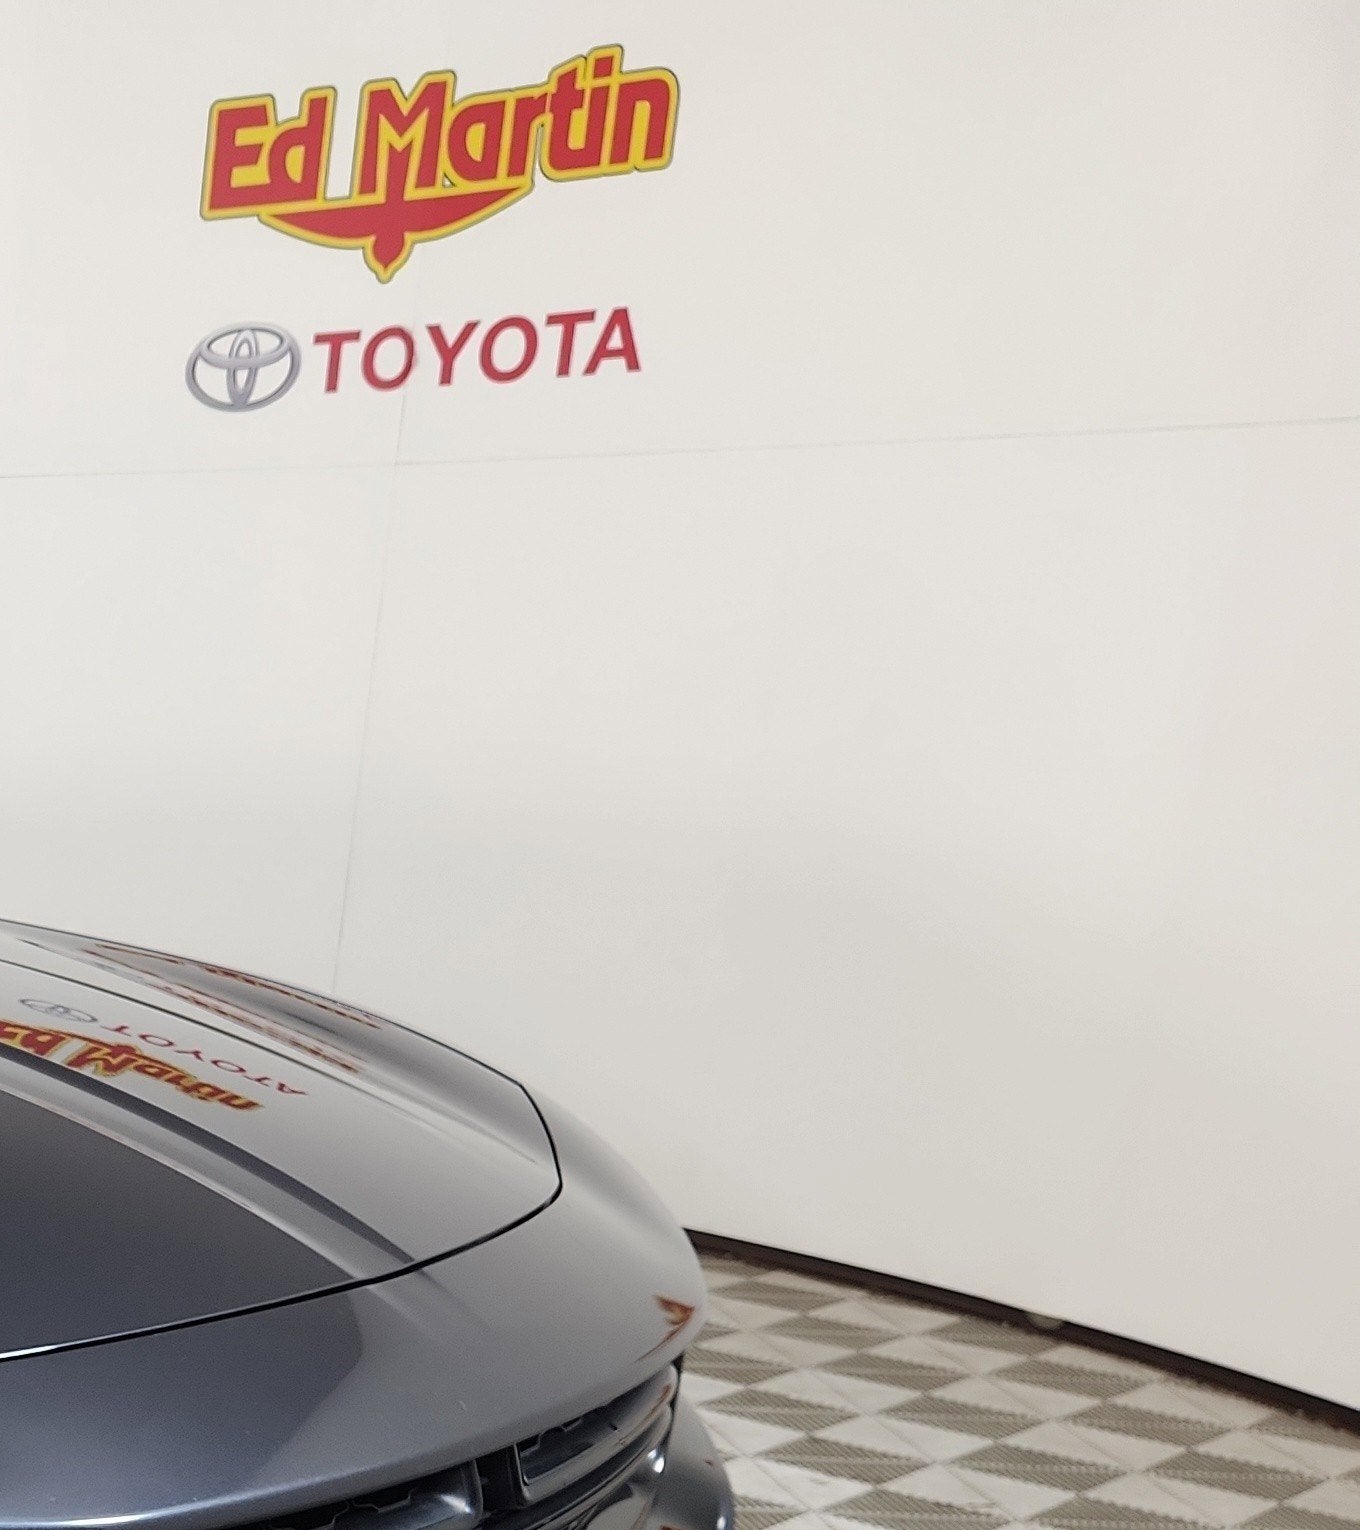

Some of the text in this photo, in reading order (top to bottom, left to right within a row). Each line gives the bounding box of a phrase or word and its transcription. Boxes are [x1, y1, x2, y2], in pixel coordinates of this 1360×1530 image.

[200, 43, 680, 220] Ed Martin
[312, 305, 641, 394] TOYOTA
